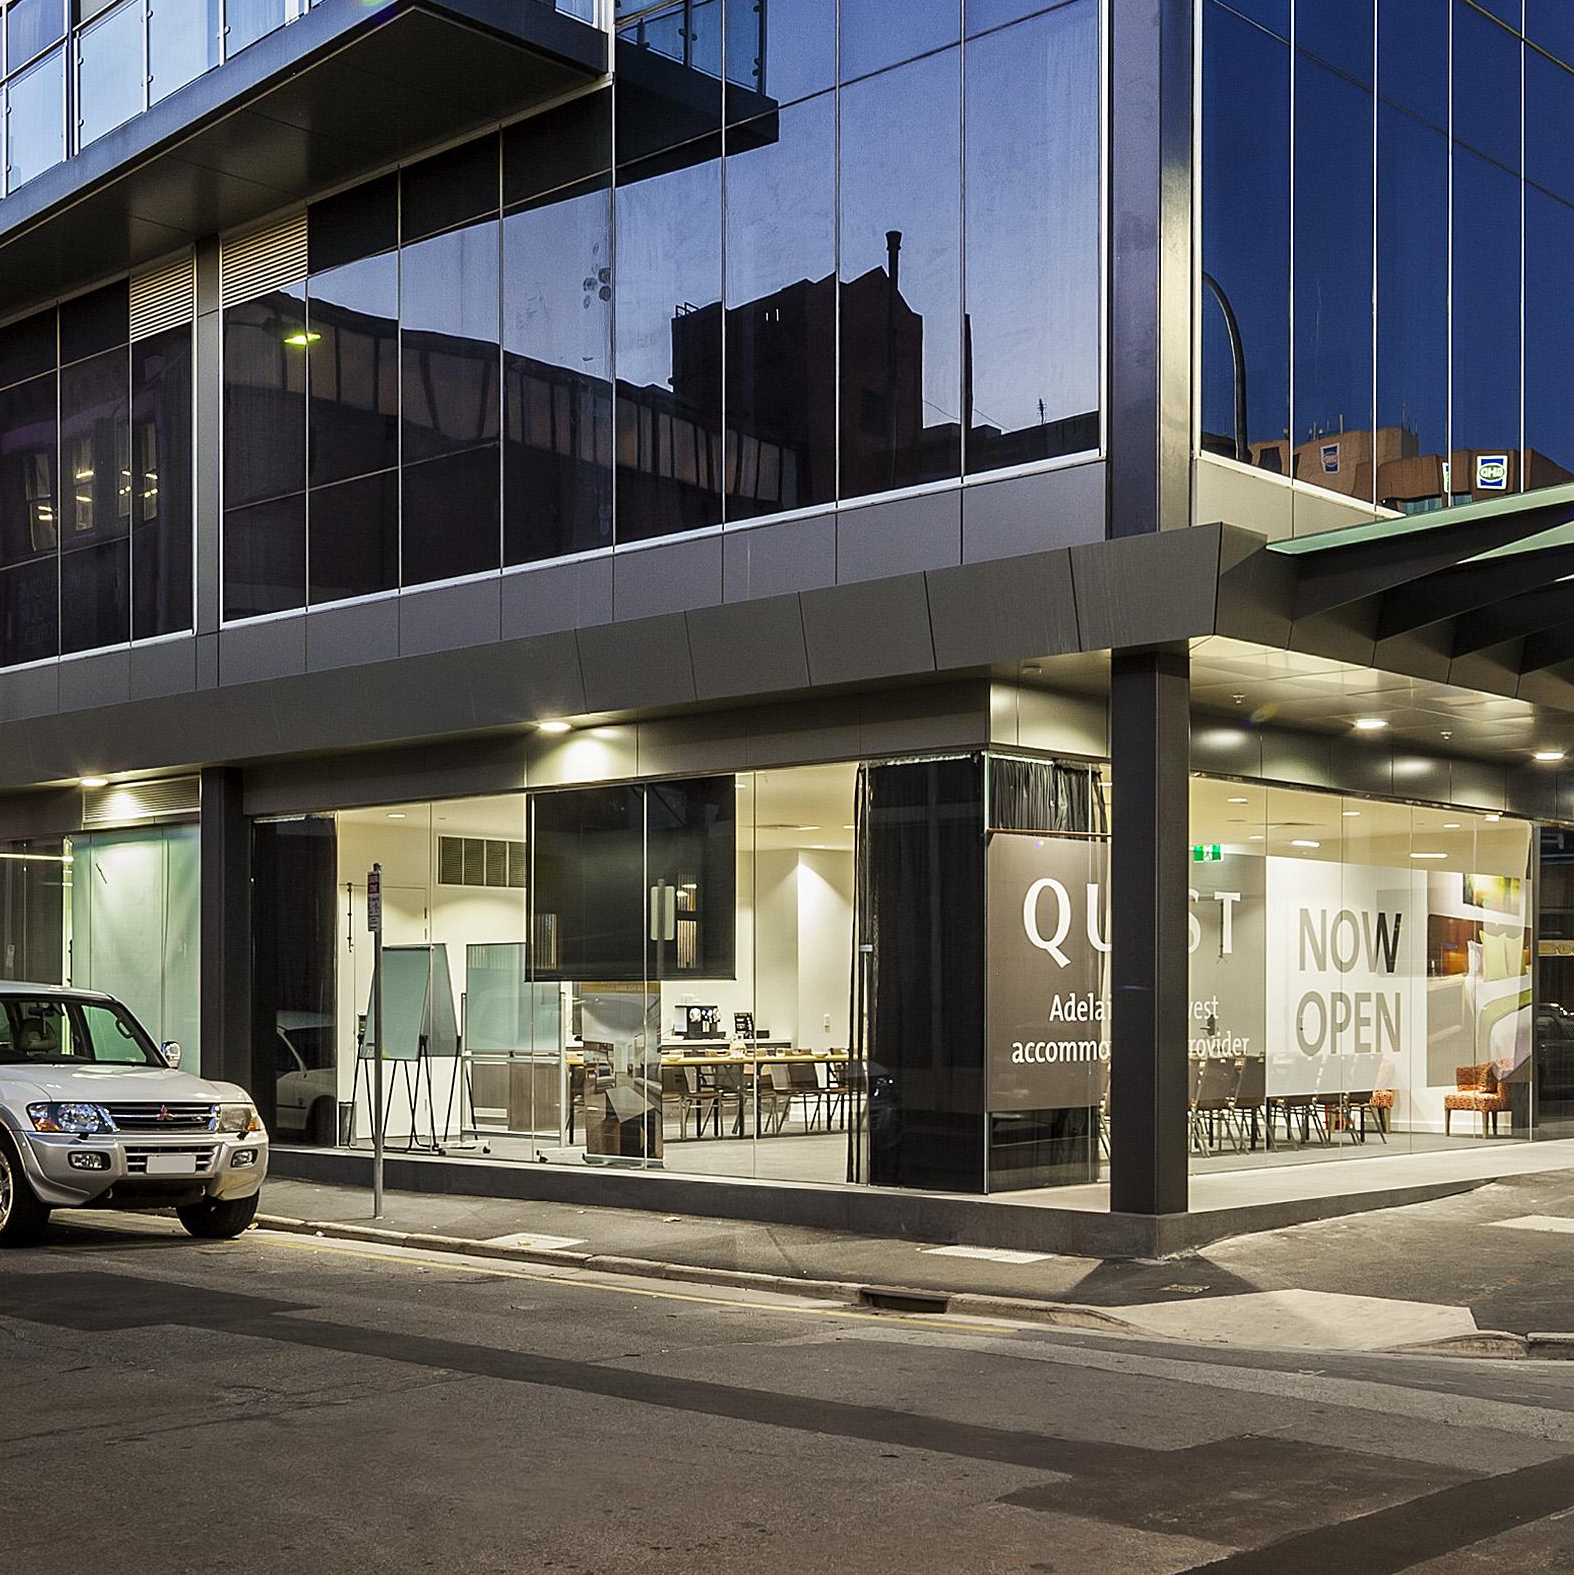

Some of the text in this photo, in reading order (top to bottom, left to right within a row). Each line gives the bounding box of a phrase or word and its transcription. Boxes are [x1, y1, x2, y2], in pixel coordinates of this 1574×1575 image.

[1023, 878, 1241, 968] QUST
[1299, 908, 1402, 973] NOW
[1049, 992, 1112, 1022] Adelai
[1296, 990, 1401, 1056] OPEN
[1011, 1031, 1249, 1064] accommo rovider
